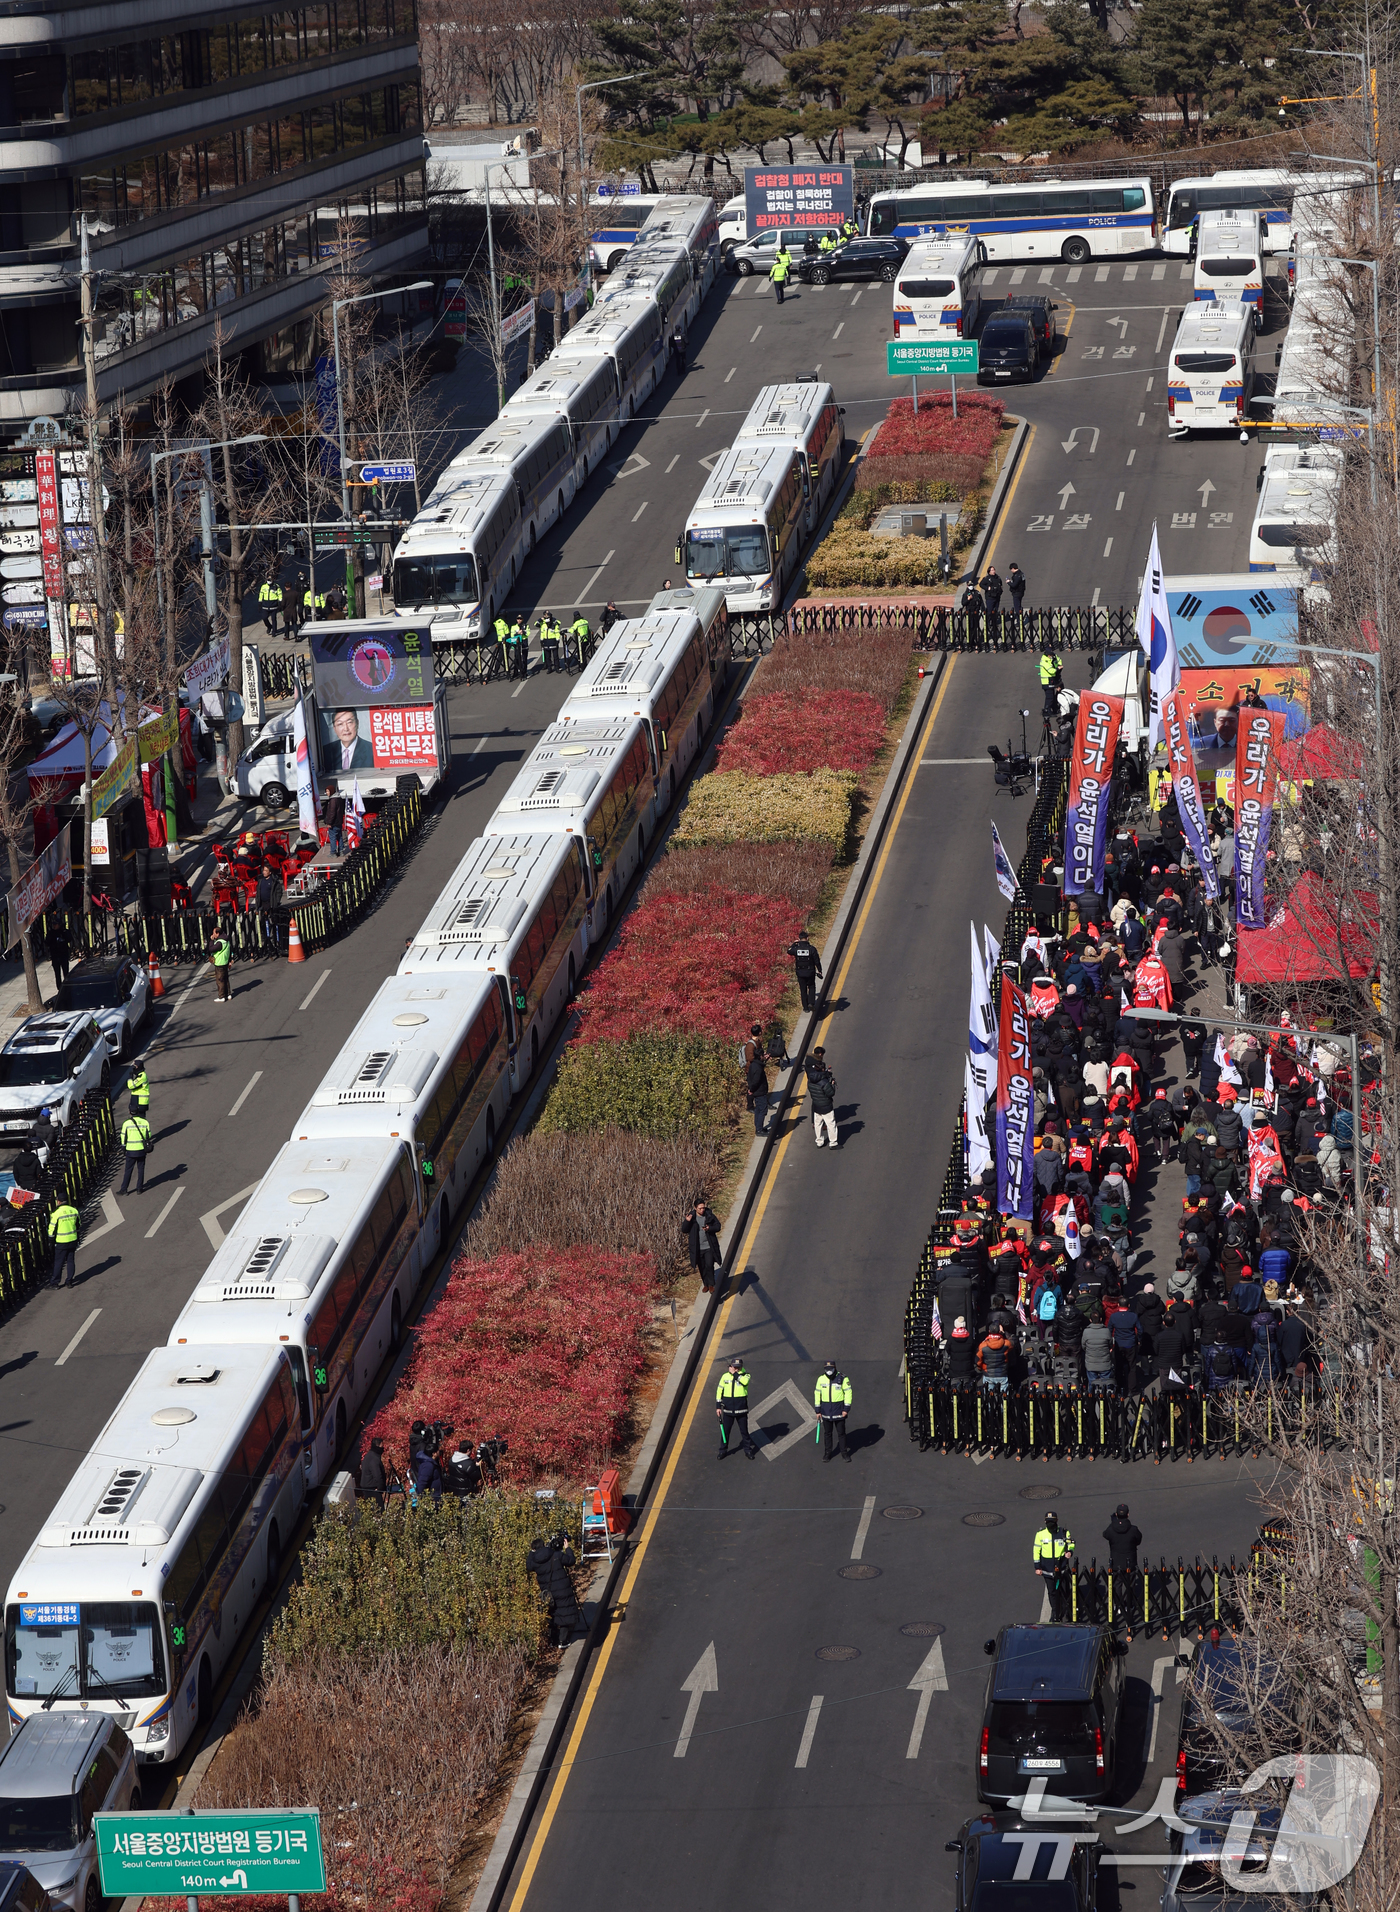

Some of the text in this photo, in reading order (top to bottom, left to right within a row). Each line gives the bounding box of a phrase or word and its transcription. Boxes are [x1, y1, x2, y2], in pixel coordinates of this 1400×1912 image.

[755, 172, 843, 188] 검찰청 폐지 반대
[766, 189, 832, 200] 검찰이 침묵하면
[766, 200, 833, 212] 법치는 무너진다
[756, 212, 845, 227] 끝까지 저항하라!
[1088, 217, 1117, 226] POLICE
[892, 346, 974, 359] 서울중앙지방법원 등기국
[1080, 345, 1138, 359] 검찰
[383, 466, 414, 475] 법원로3길
[38, 459, 57, 520] 中華料理
[1026, 513, 1093, 532] 검찰
[1170, 512, 1235, 529] 법원
[403, 632, 424, 697] 윤석열
[373, 711, 435, 734] 윤석열 대통령
[375, 734, 437, 757] 완전무죄
[1073, 701, 1111, 885] 우리가 윤석열이다
[1237, 717, 1272, 922] 우리가 윤석열이다
[516, 995, 526, 1009] 32
[422, 1161, 433, 1176] 36
[315, 1368, 327, 1385] 36
[37, 1605, 77, 1614] 서울기동경찰
[37, 1615, 77, 1623] 제36기동대-2
[173, 1627, 186, 1646] 36
[113, 1829, 308, 1856] 서울중앙지방법원 등기국
[122, 1860, 143, 1868] Seoul
[145, 1860, 173, 1868] Central
[174, 1859, 202, 1867] District
[226, 1858, 272, 1867] Registration
[273, 1857, 300, 1865] Bureau
[181, 1875, 217, 1887] 140m
